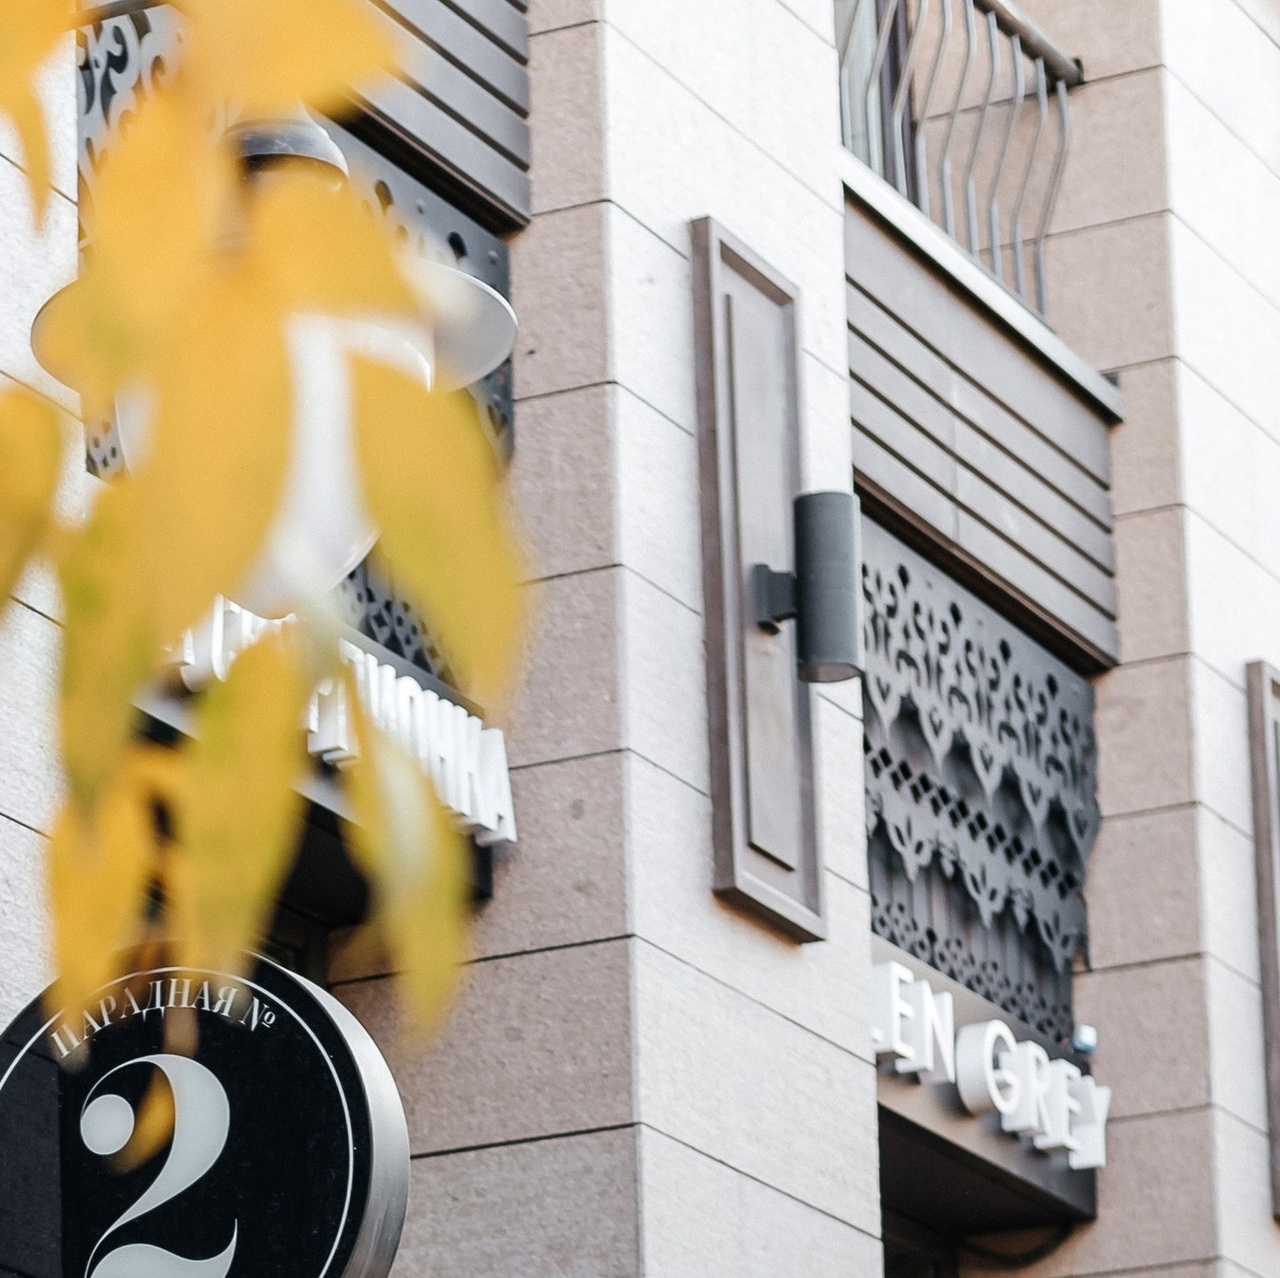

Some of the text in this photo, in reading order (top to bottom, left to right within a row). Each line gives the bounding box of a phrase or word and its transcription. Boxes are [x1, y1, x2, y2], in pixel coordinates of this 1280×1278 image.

[50, 978, 239, 1058] ПАРАДНАЯ
[871, 961, 1111, 1169] EN GREY
